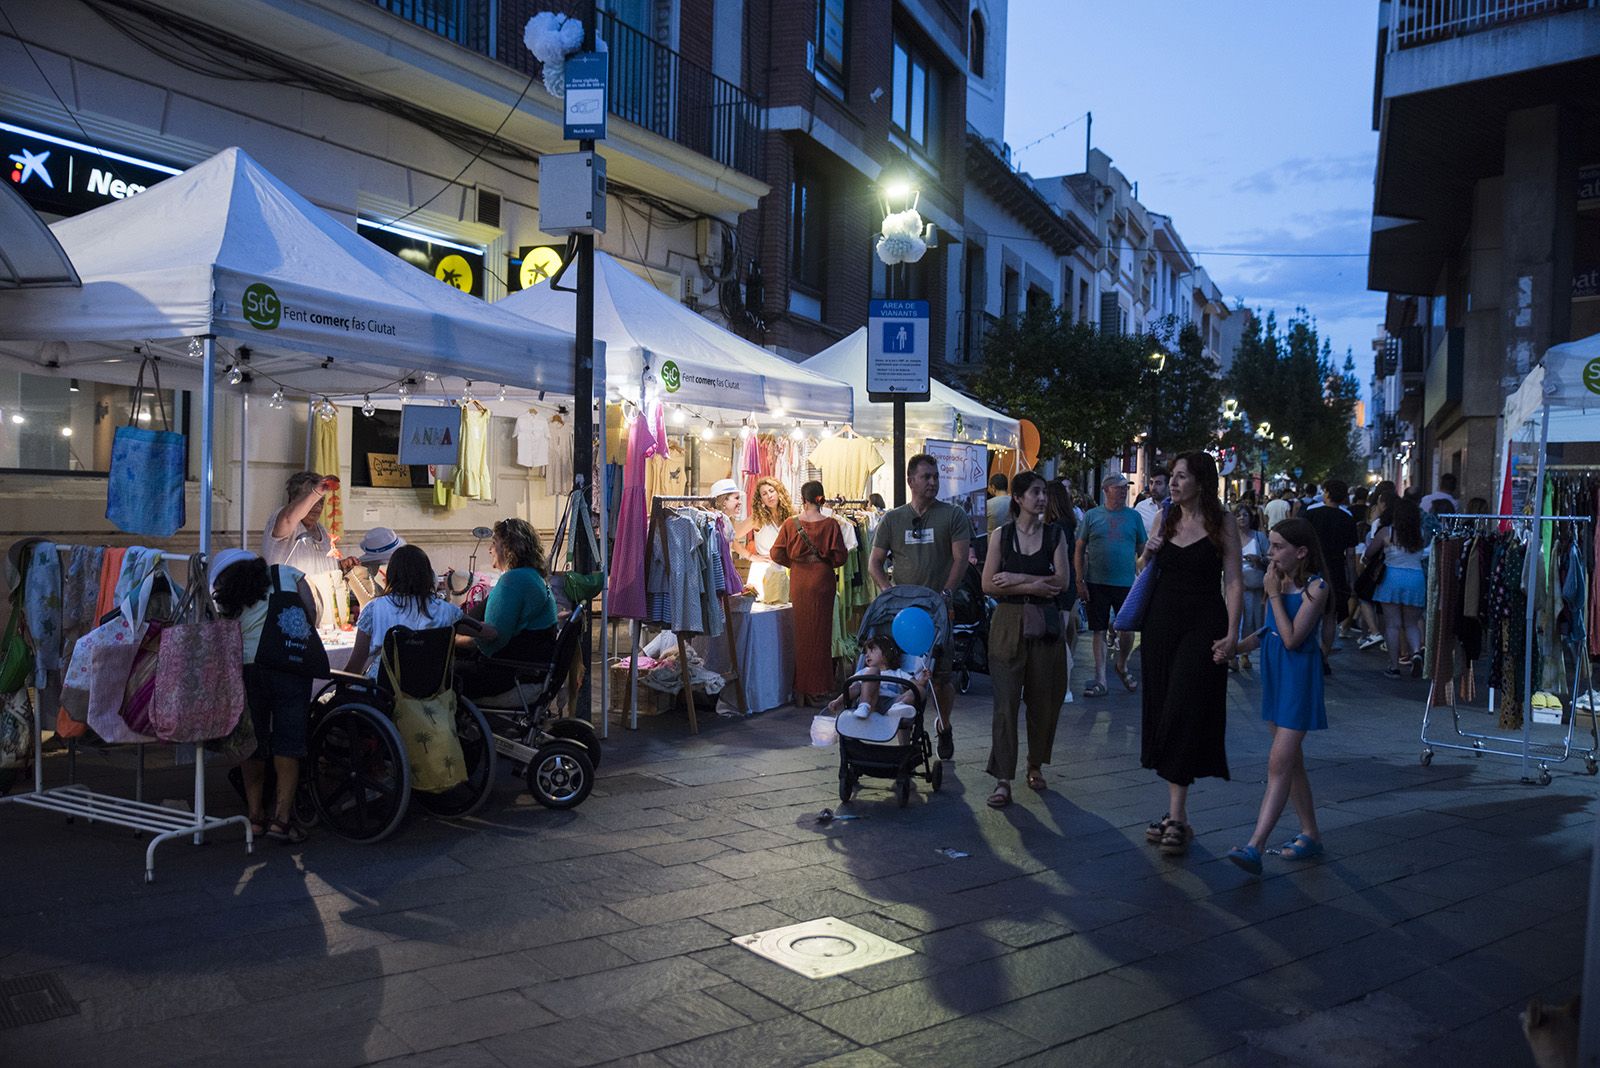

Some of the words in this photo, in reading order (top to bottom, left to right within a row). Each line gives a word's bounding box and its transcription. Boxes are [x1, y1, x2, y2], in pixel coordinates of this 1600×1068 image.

[283, 306, 307, 322] Fent
[310, 313, 350, 331] comerç
[352, 316, 366, 331] fas
[367, 320, 396, 336] Ciutat
[682, 373, 695, 383] Fent
[695, 377, 715, 387] comerç
[716, 378, 724, 387] fas
[724, 379, 740, 389] Ciutat
